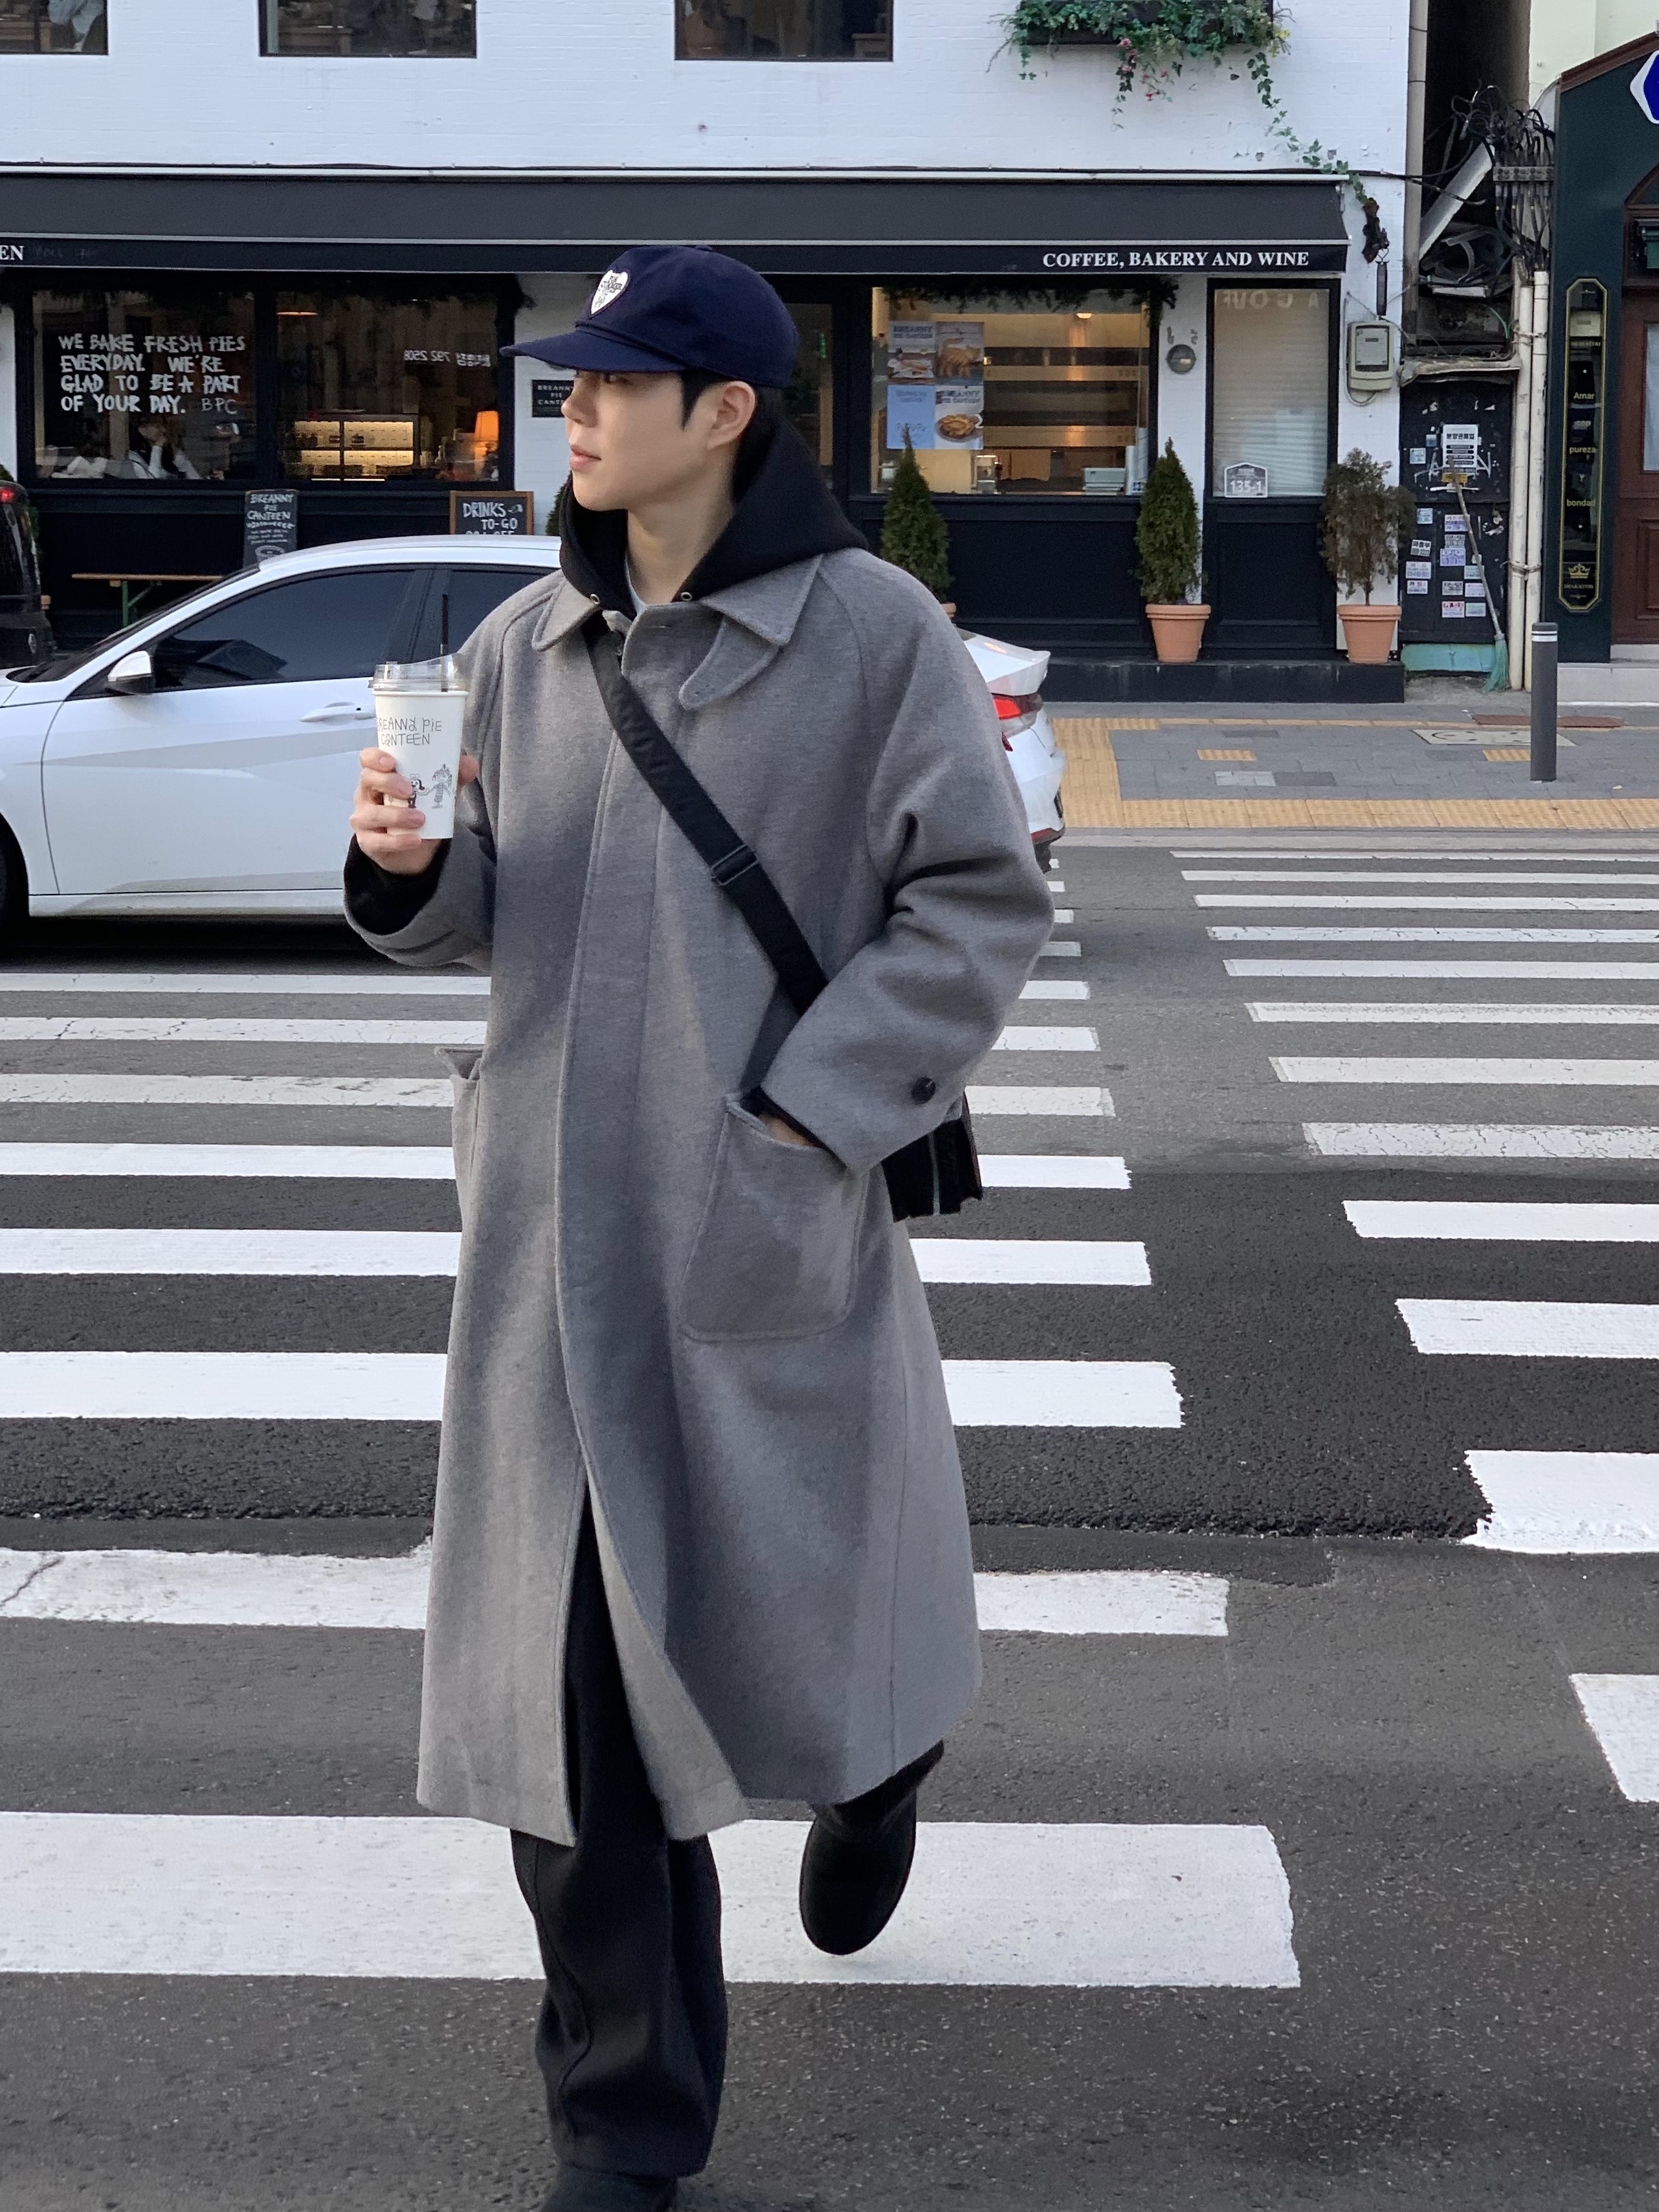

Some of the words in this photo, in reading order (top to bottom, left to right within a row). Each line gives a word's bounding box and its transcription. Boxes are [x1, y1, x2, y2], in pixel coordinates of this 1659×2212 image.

[1043, 252, 1124, 269] COFFEE,
[1129, 252, 1208, 266] BAKERY
[1212, 252, 1253, 266] AND
[1257, 251, 1309, 266] WINE
[58, 333, 84, 350] WE
[89, 333, 134, 352] BAKE
[144, 335, 203, 353] FRESH
[209, 335, 246, 352] PIES
[60, 374, 104, 393] GLAD
[115, 375, 139, 391] TO
[150, 374, 173, 391] BE
[178, 375, 194, 393] A
[202, 375, 240, 394] PART
[60, 395, 84, 412] OF
[93, 393, 141, 413] YOUR
[150, 395, 186, 414] DAY.
[201, 397, 238, 414] BPC
[1230, 480, 1261, 493] 135-1
[463, 502, 506, 517] DRINKS
[1566, 498, 1596, 507] bondad
[480, 517, 518, 530] TO-GO
